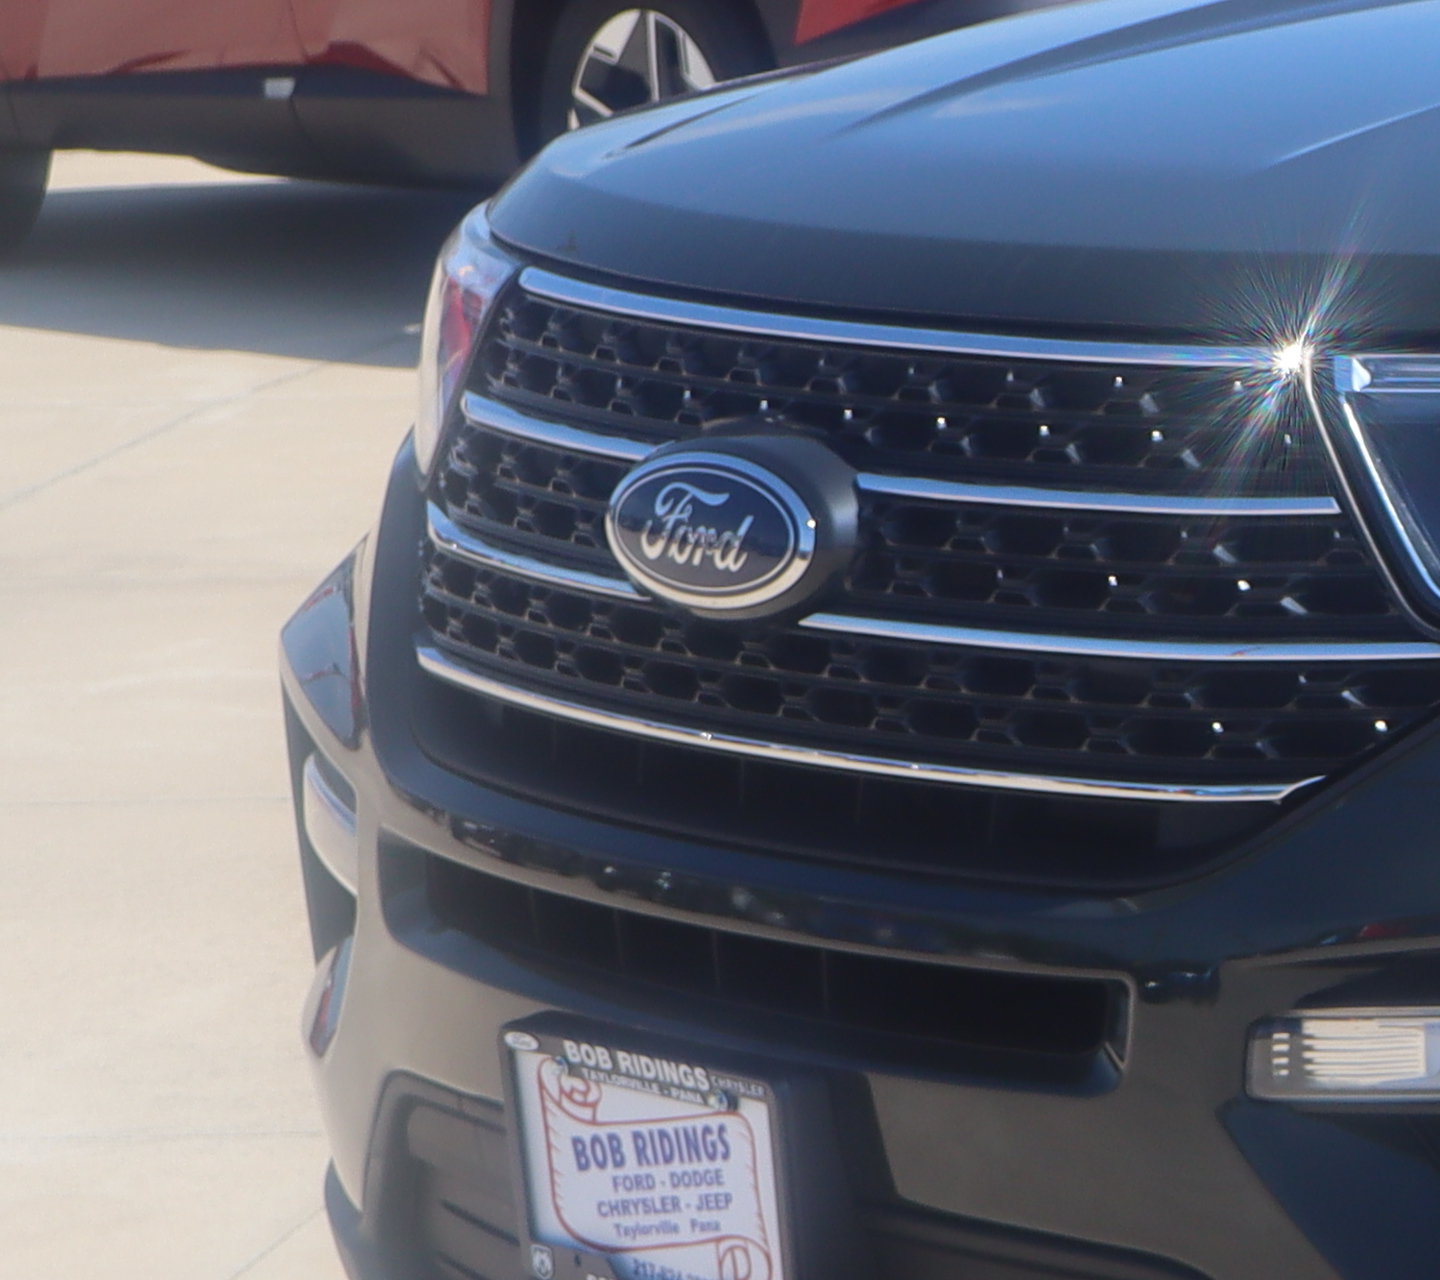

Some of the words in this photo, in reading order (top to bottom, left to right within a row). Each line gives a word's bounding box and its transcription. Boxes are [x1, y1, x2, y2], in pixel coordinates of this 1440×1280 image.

[640, 481, 754, 572] Ford
[563, 1039, 613, 1069] BOB
[616, 1050, 710, 1091] RIDINGS
[581, 1067, 661, 1095] TAYLORVILLE
[711, 1075, 766, 1096] CHRYSLER
[571, 1133, 626, 1171] BOB
[631, 1123, 731, 1167] RIDINGS
[612, 1173, 656, 1193] FORD
[670, 1169, 725, 1189] DODGE
[597, 1195, 682, 1218] CHRYSLER
[695, 1192, 734, 1211] JEEP
